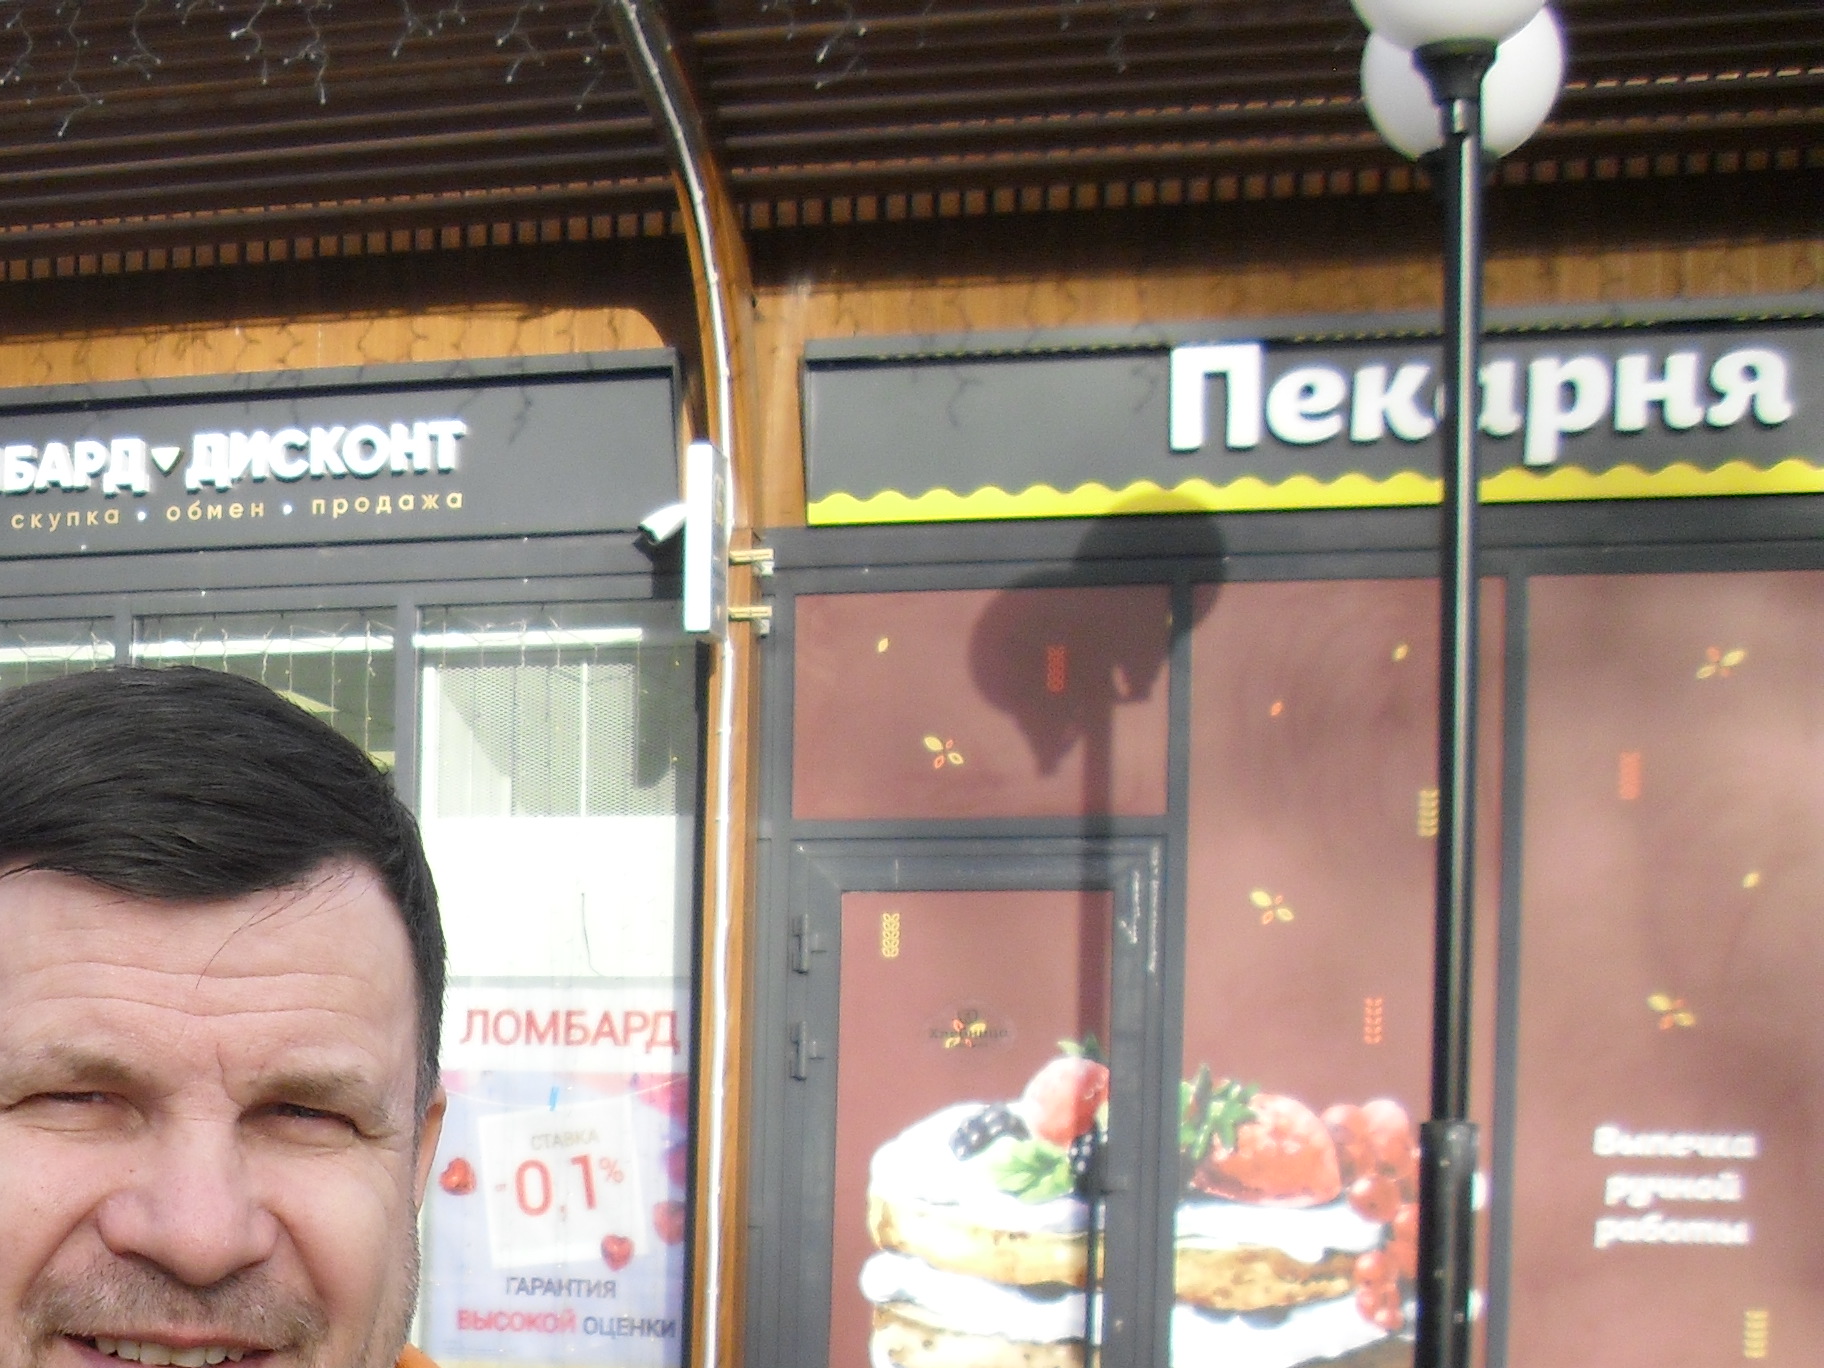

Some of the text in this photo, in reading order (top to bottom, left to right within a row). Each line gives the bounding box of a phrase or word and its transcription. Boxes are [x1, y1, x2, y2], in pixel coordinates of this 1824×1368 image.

[1169, 342, 1795, 467] Пекарня
[185, 420, 468, 494] ДИСКОНТ
[11, 507, 120, 533] скупка
[166, 499, 265, 521] обмен
[311, 490, 464, 519] продажа
[460, 1007, 681, 1055] ЛОМБАРД
[505, 1276, 617, 1299] ГАРАНТИЯ
[457, 1307, 676, 1339] ВЫСОКОЙ ОЦЕНКИ
